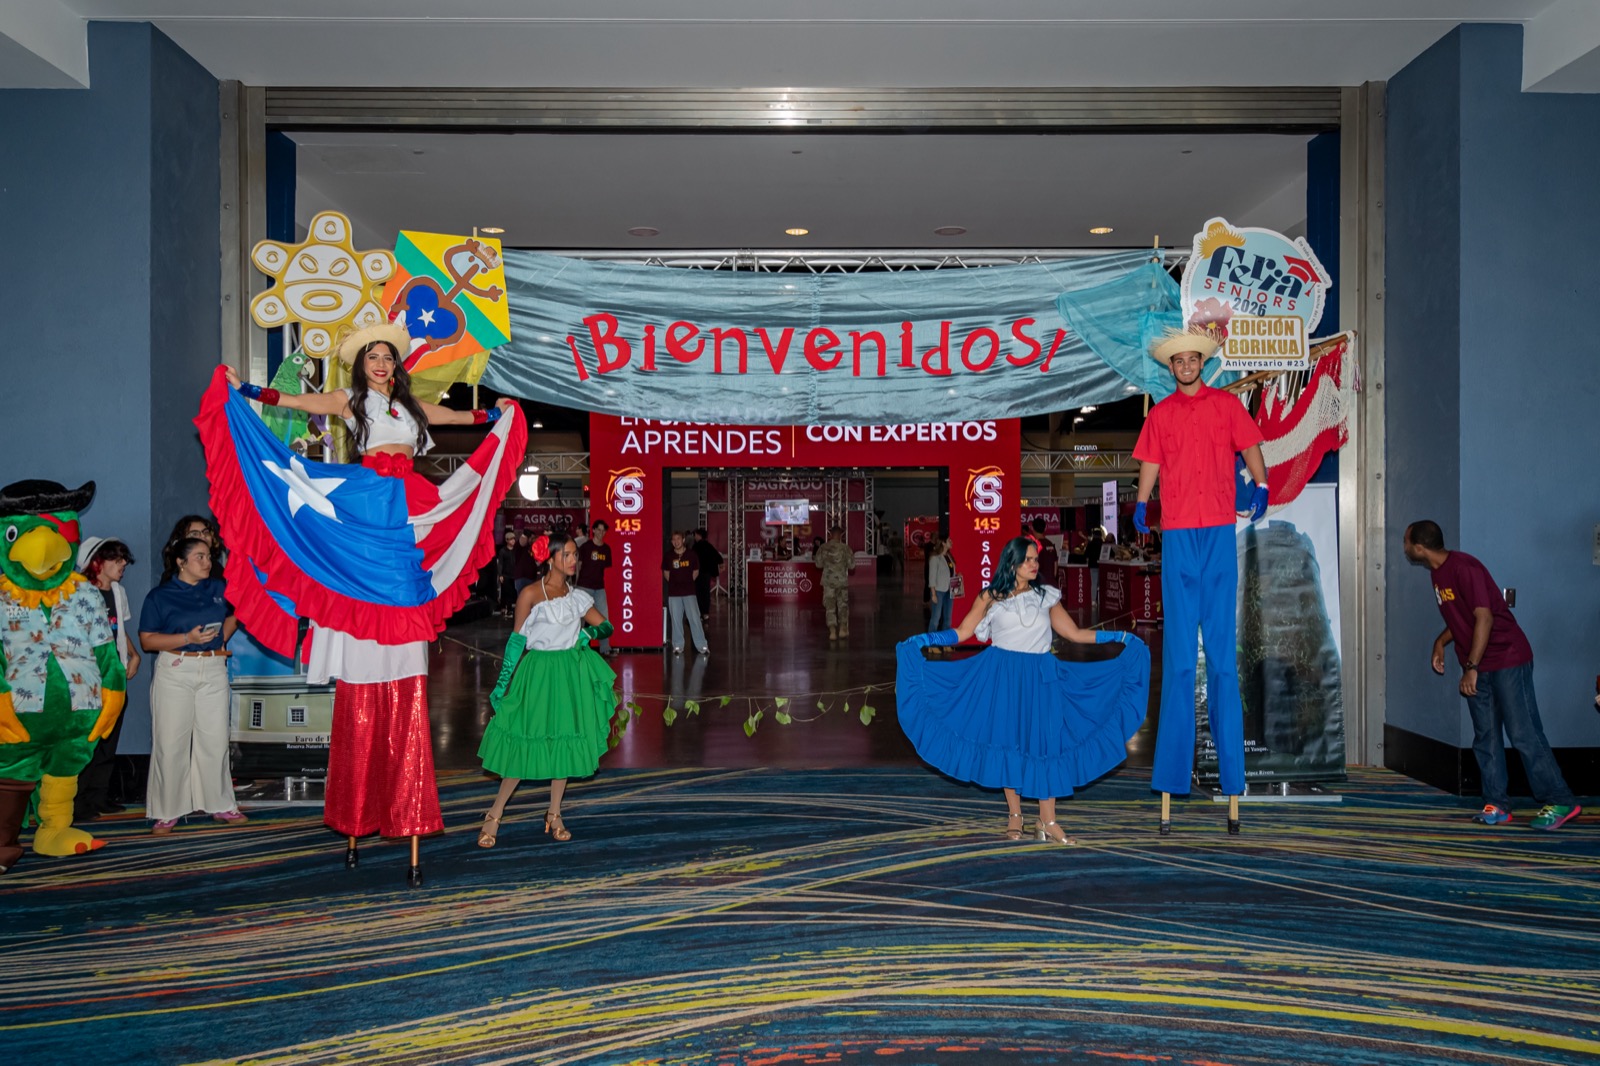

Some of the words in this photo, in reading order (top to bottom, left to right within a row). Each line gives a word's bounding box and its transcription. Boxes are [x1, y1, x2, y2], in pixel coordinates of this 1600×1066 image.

[1207, 246, 1302, 299] Feria
[1204, 278, 1297, 311] SENIORS
[1232, 297, 1267, 317] 2026
[1232, 318, 1294, 336] EDICIÓN
[566, 312, 1067, 382] ¡Bienvenidos!
[1229, 339, 1299, 355] BORIKUA
[806, 424, 862, 442] CON
[870, 421, 997, 442] EXPERTOS
[621, 430, 782, 454] APRENDES
[749, 479, 823, 490] SAGRADO
[615, 518, 641, 532] 145
[975, 517, 1000, 530] 145
[764, 570, 807, 579] EDUCACIÓN
[622, 542, 634, 633] SAGRADO
